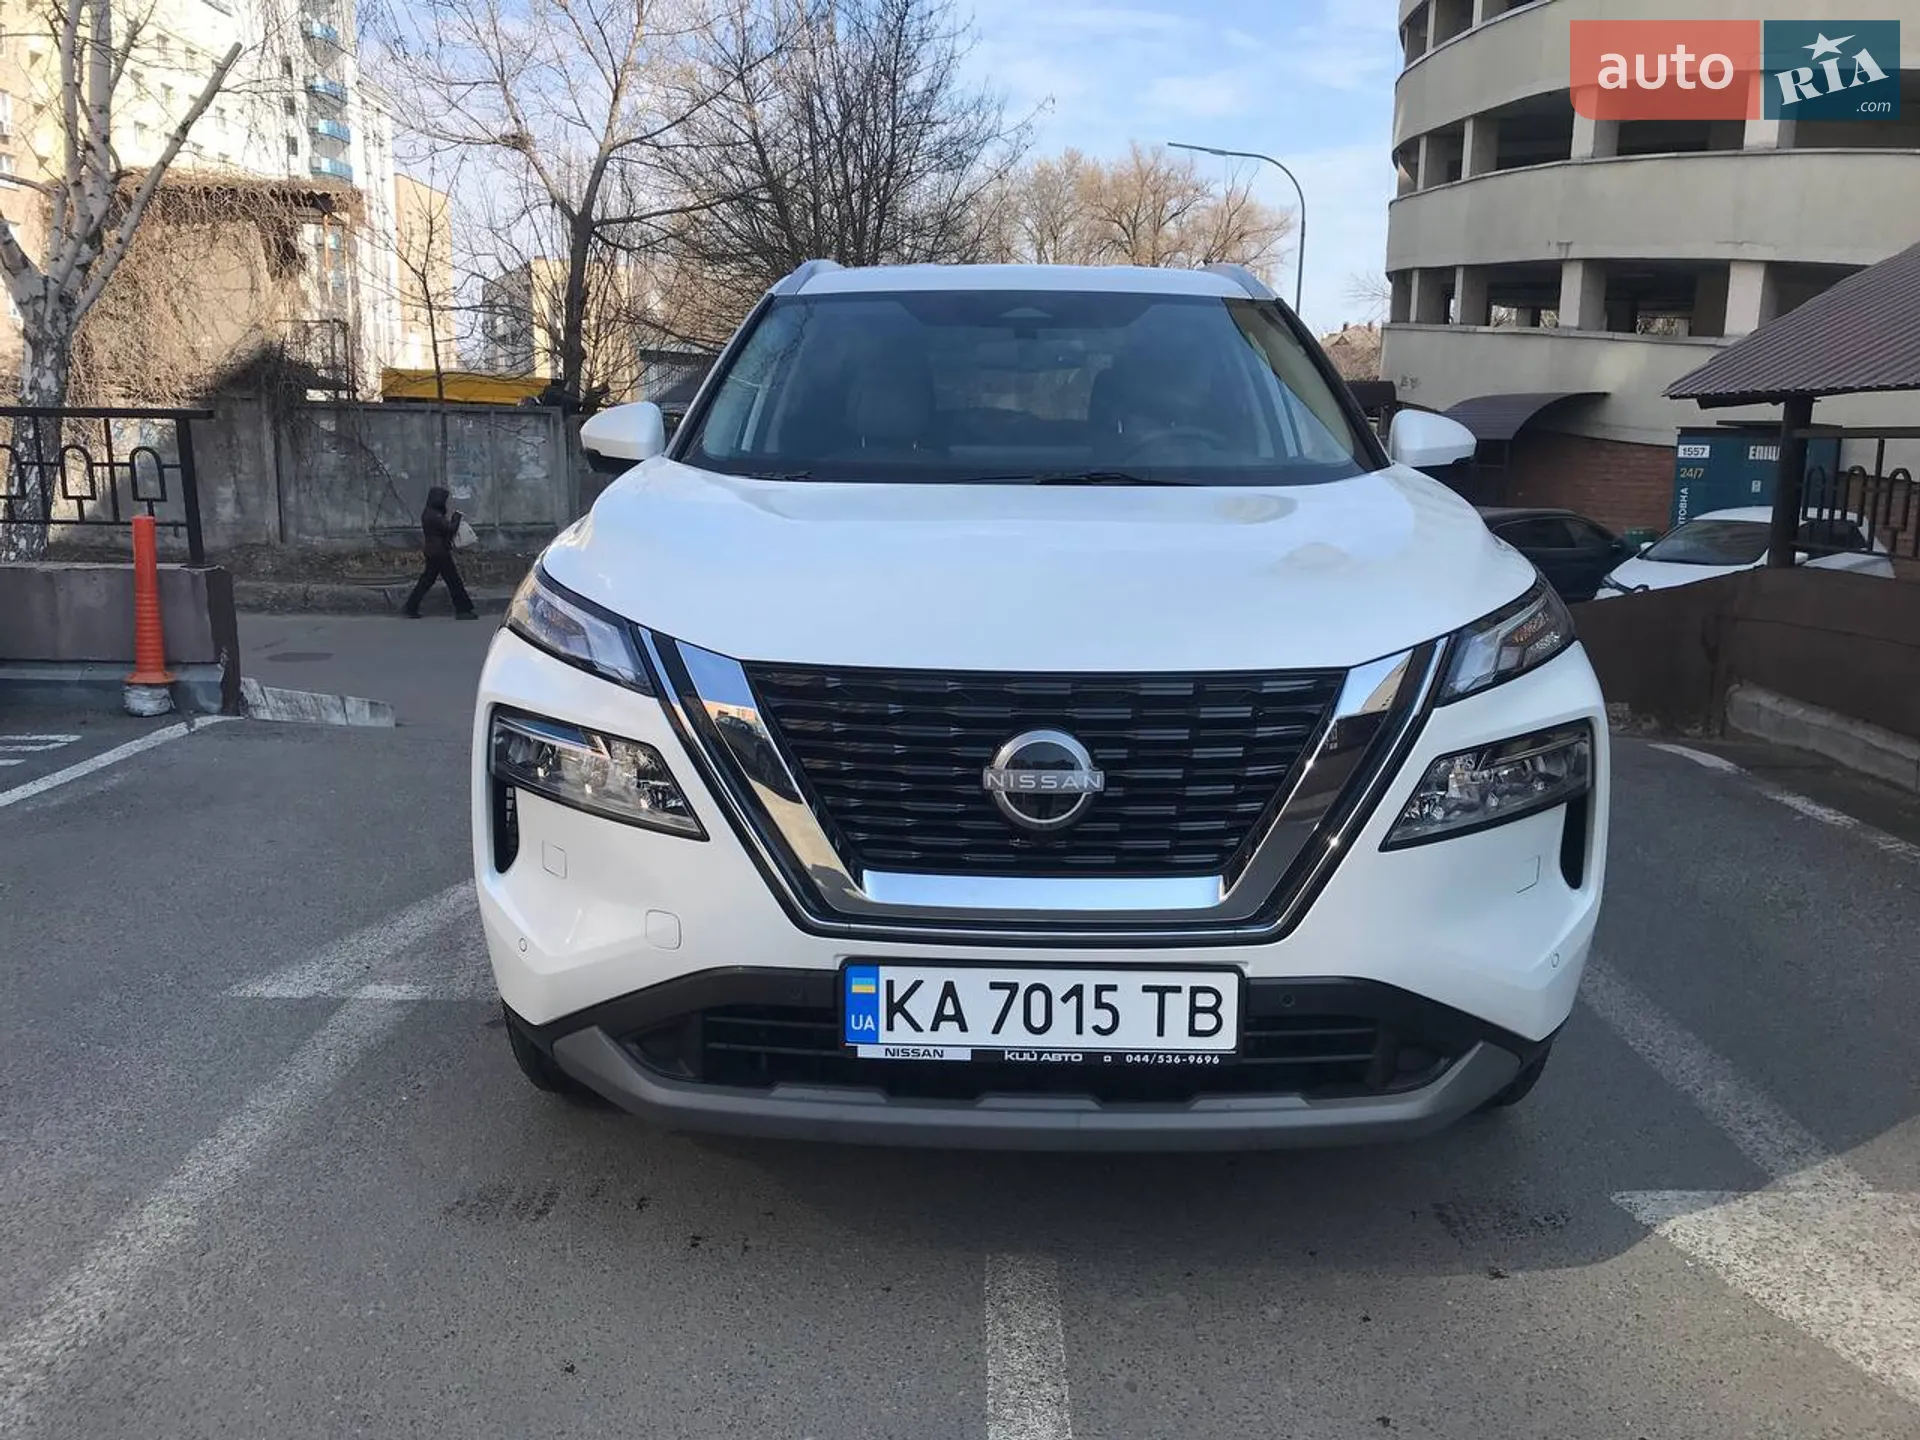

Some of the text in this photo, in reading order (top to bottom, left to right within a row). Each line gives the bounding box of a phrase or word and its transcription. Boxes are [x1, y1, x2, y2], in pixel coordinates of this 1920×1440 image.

[1681, 447, 1705, 456] 1557
[1679, 468, 1704, 478] 24/7
[987, 773, 1100, 789] NISSAN
[988, 981, 1120, 1037] 7015
[851, 1014, 875, 1031] UA
[884, 1047, 945, 1059] NISSAN
[1125, 1054, 1220, 1065] 044/536-9696
